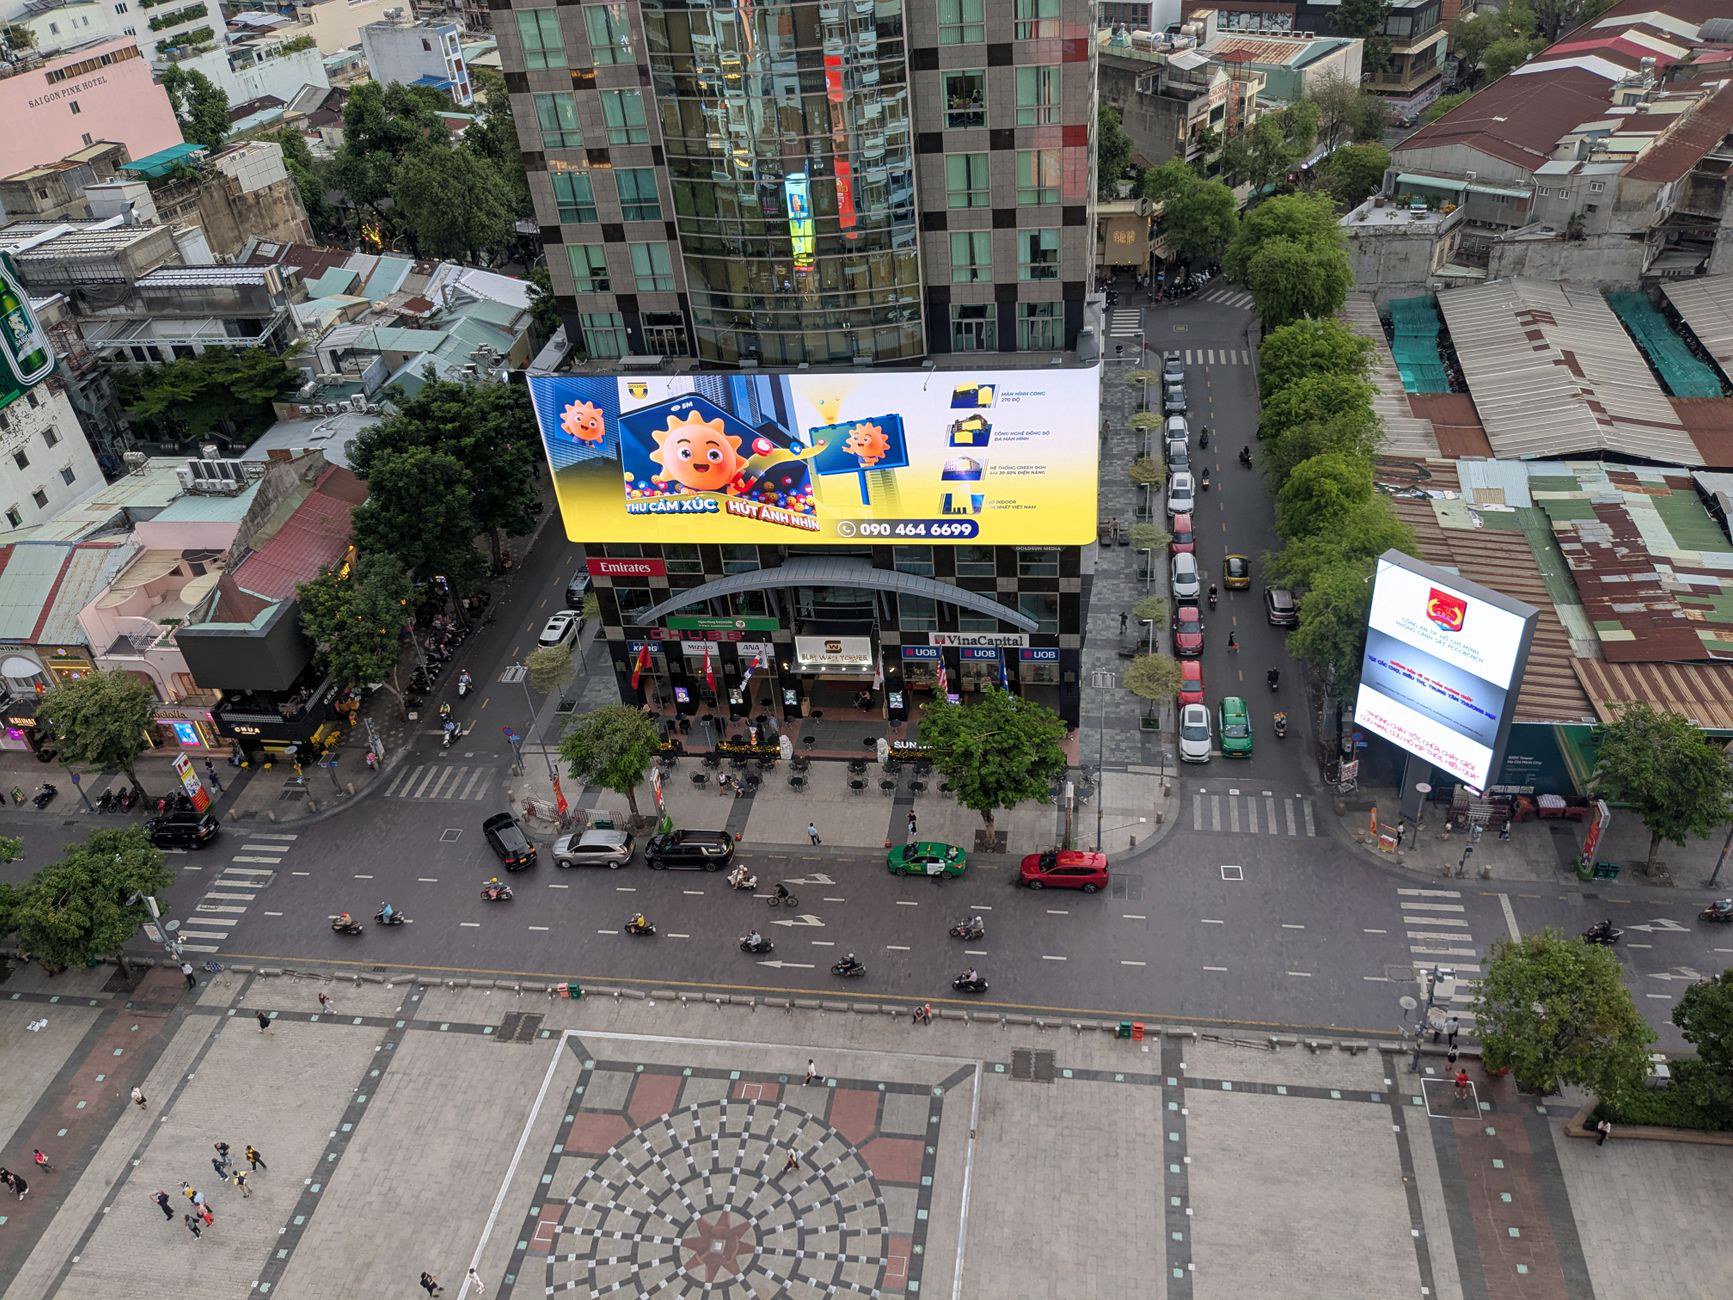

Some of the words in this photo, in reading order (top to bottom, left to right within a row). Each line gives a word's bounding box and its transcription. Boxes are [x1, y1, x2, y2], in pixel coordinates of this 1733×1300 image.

[28, 91, 61, 108] SAIGON
[61, 83, 82, 98] PINK
[82, 76, 107, 91] HOTEL
[626, 503, 649, 512] THU
[650, 498, 680, 511] CẢM
[681, 497, 719, 511] XÚC
[729, 502, 758, 516] HÚT
[860, 523, 890, 536] 090
[895, 523, 926, 536] 464
[930, 523, 972, 536] 6699
[600, 562, 651, 573] Emirates
[650, 629, 742, 640] CHUBB
[947, 635, 1023, 647] VinaCapital
[974, 650, 996, 658] UOB
[1033, 651, 1056, 659] UOB
[894, 741, 917, 749] SUN
